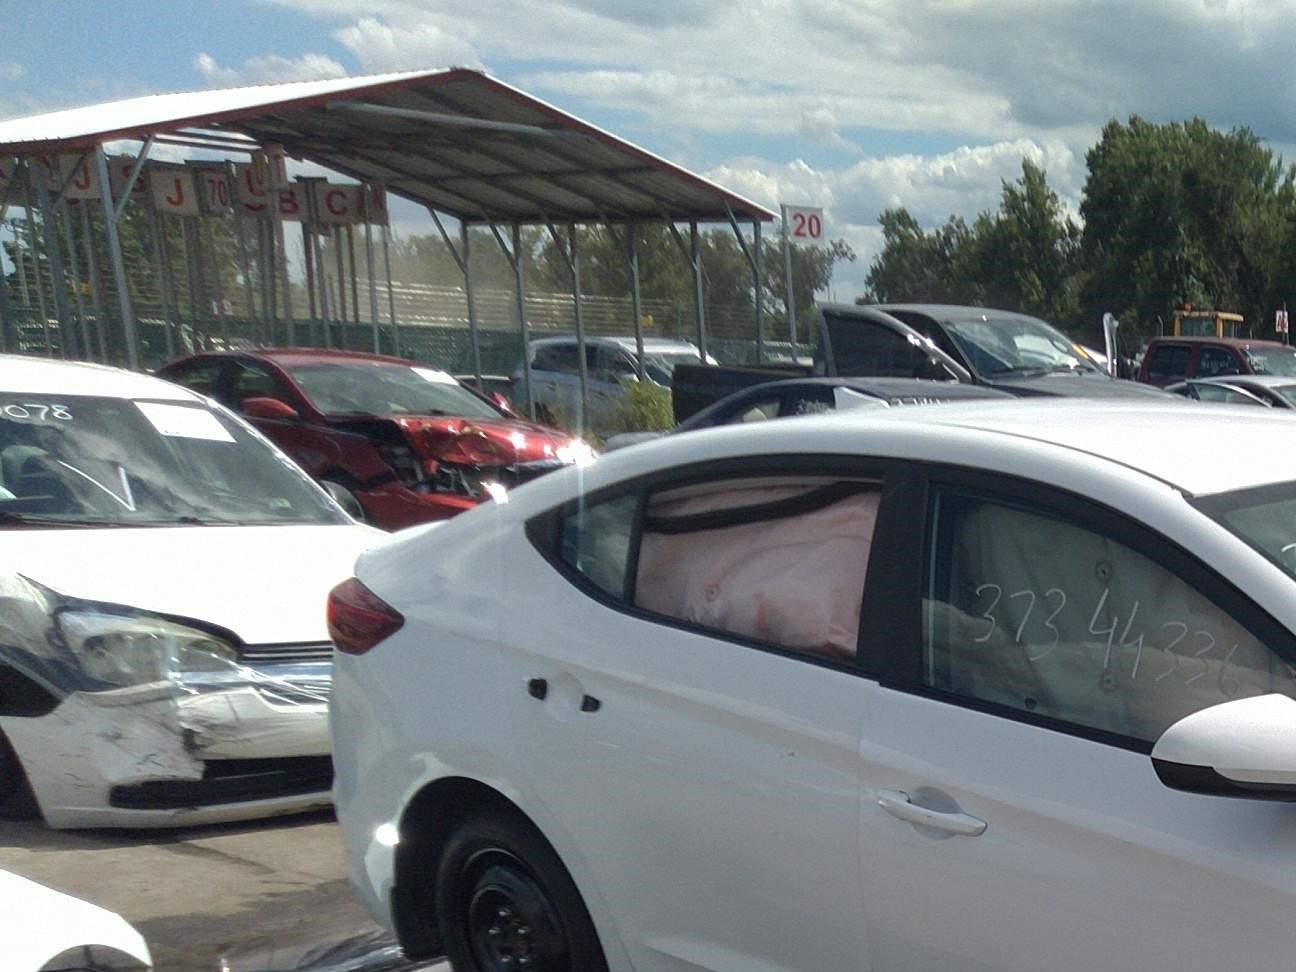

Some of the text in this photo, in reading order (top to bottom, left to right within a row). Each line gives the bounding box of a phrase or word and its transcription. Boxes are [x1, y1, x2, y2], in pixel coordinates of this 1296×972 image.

[166, 178, 185, 206] J
[326, 188, 348, 216] C
[792, 213, 822, 238] 20
